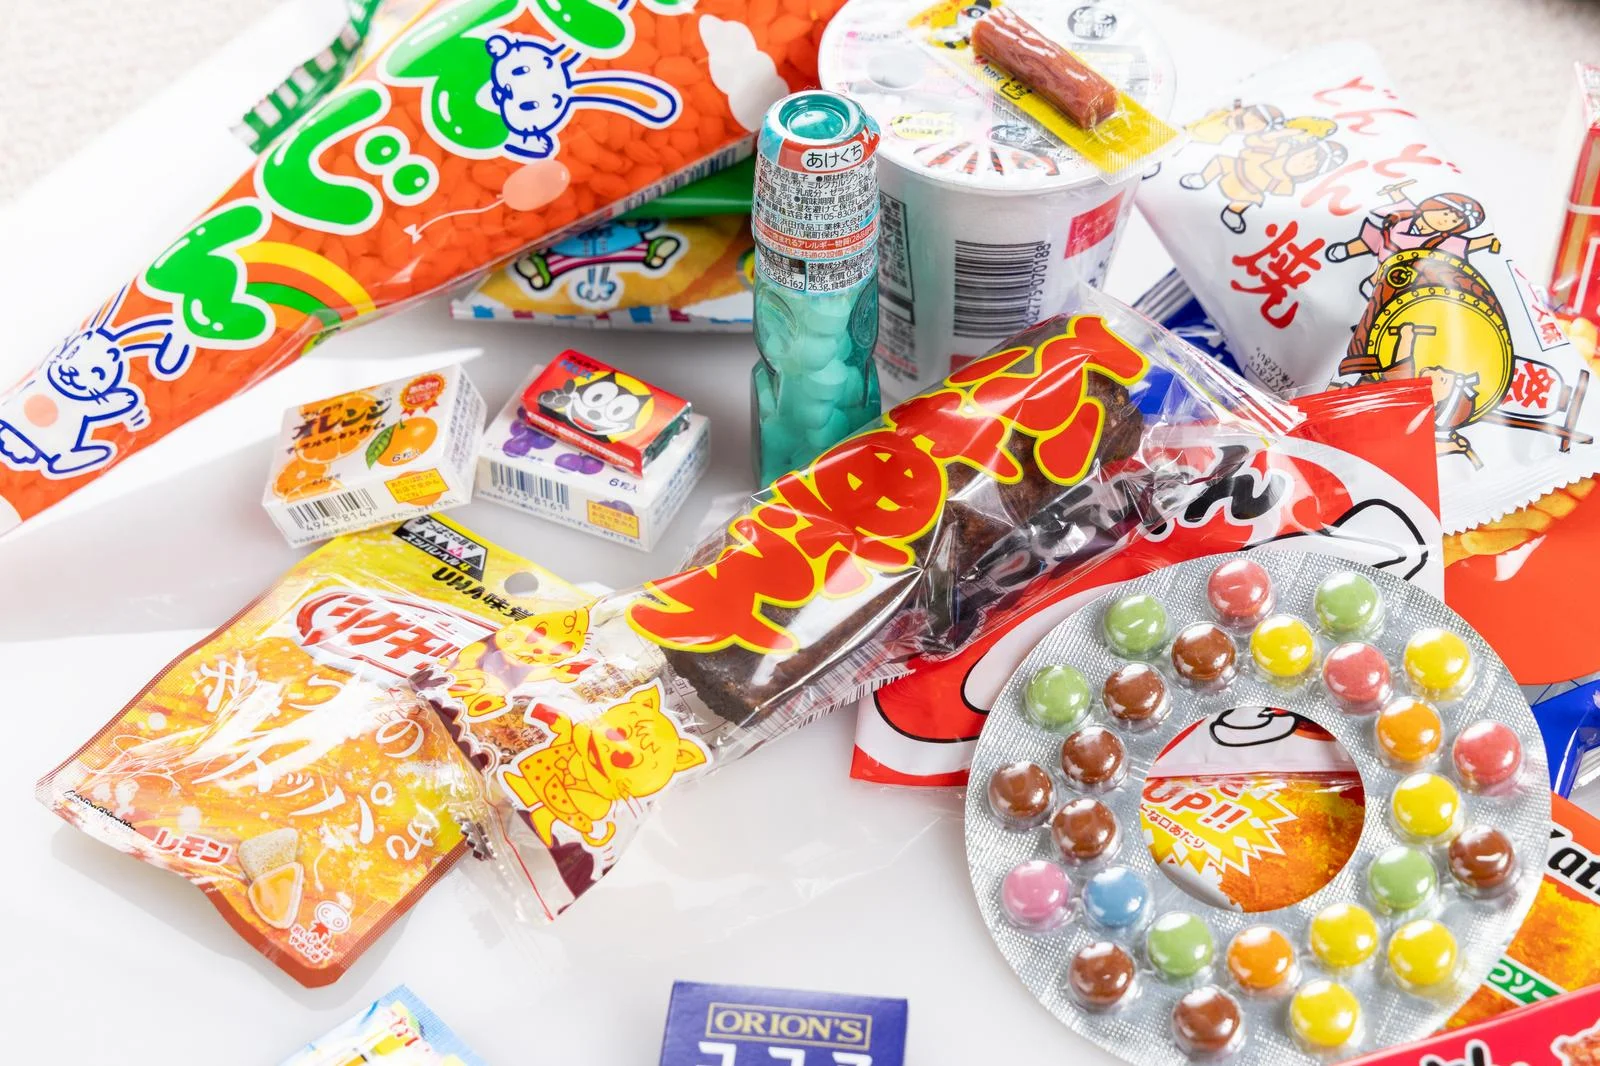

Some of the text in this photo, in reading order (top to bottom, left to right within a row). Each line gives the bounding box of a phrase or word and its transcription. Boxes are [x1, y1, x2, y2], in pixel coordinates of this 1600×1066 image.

[806, 144, 862, 169] あけくち
[292, 397, 393, 441] オレンジ
[305, 507, 375, 533] 4943 8147
[155, 830, 229, 864] レモン
[1550, 829, 1600, 896] at
[714, 1010, 864, 1043] ORION'S
